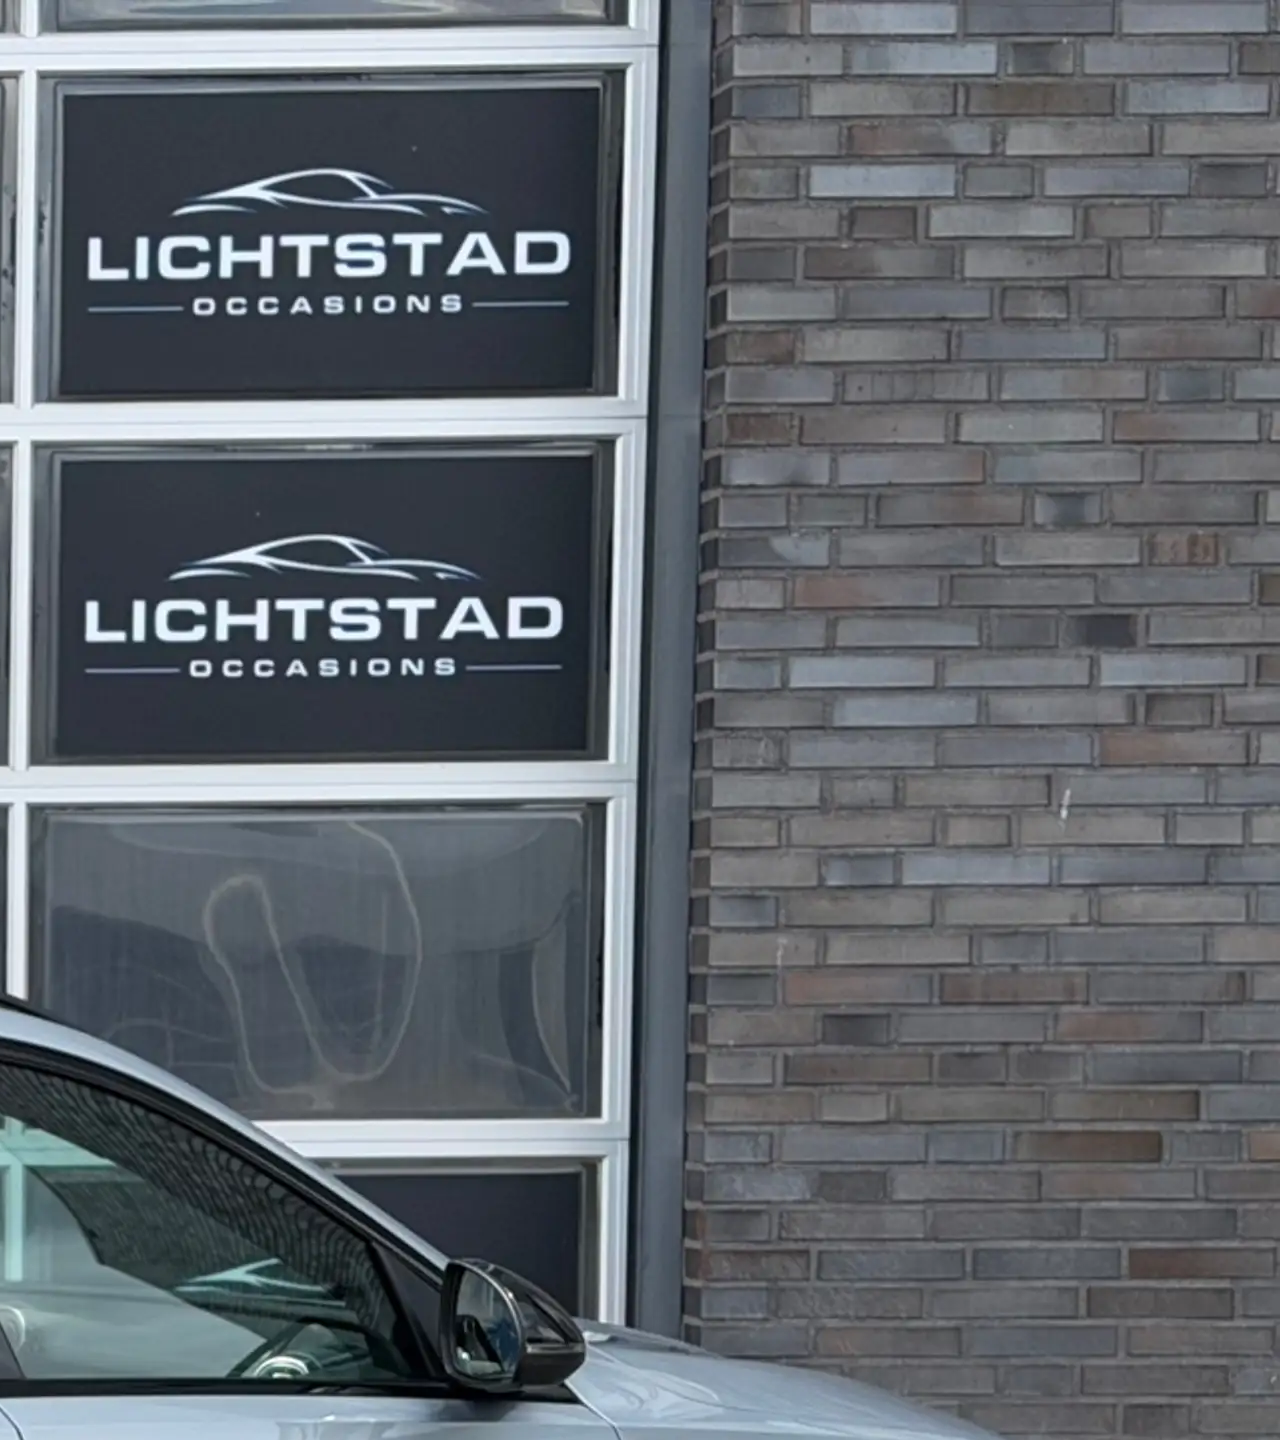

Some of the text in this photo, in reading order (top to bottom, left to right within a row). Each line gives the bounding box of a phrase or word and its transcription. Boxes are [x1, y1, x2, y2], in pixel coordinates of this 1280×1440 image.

[87, 231, 571, 281] LICHTSTAD
[192, 294, 462, 316] OCCASIONS
[84, 596, 563, 643] LICHTSTAD
[189, 657, 456, 678] OCCASIONS
